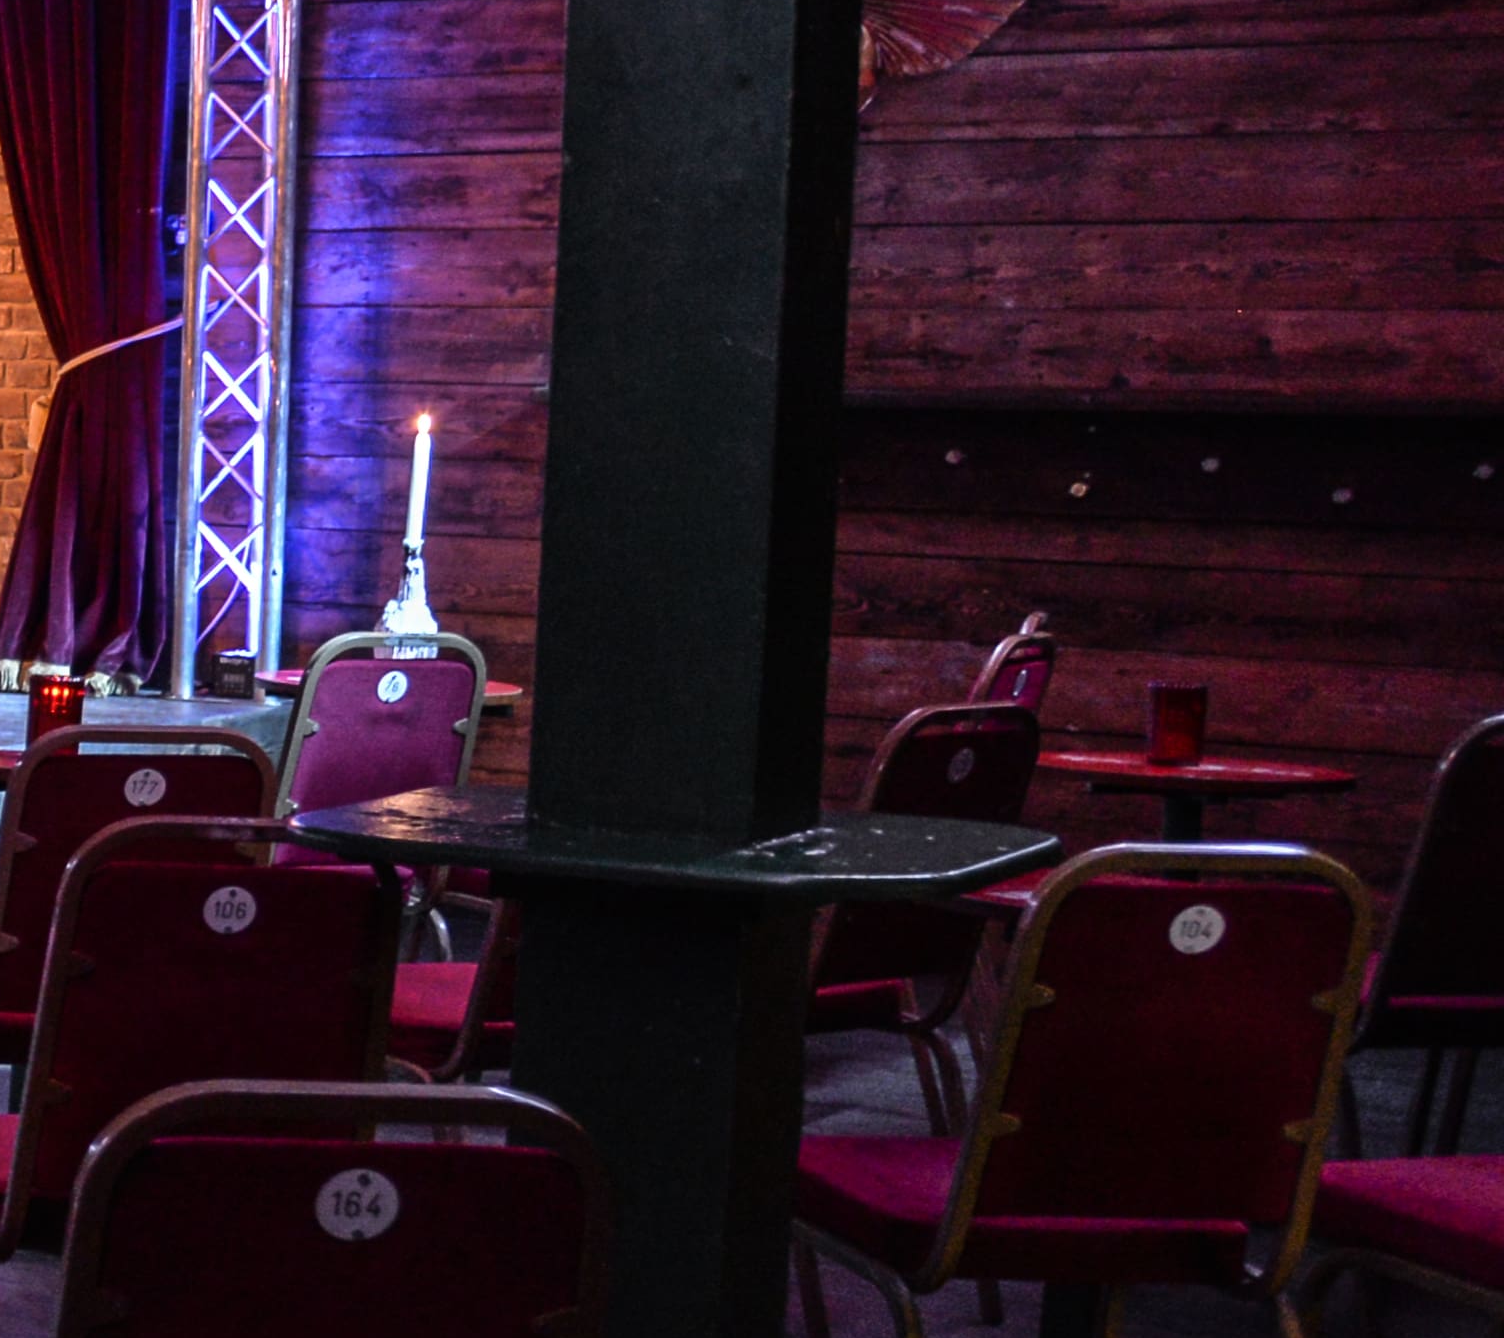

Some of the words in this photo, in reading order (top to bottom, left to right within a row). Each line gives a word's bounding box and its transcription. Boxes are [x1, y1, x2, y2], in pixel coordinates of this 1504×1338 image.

[132, 780, 159, 795] 177
[215, 901, 247, 919] 106
[1180, 920, 1214, 939] 104
[331, 1190, 382, 1218] 164
